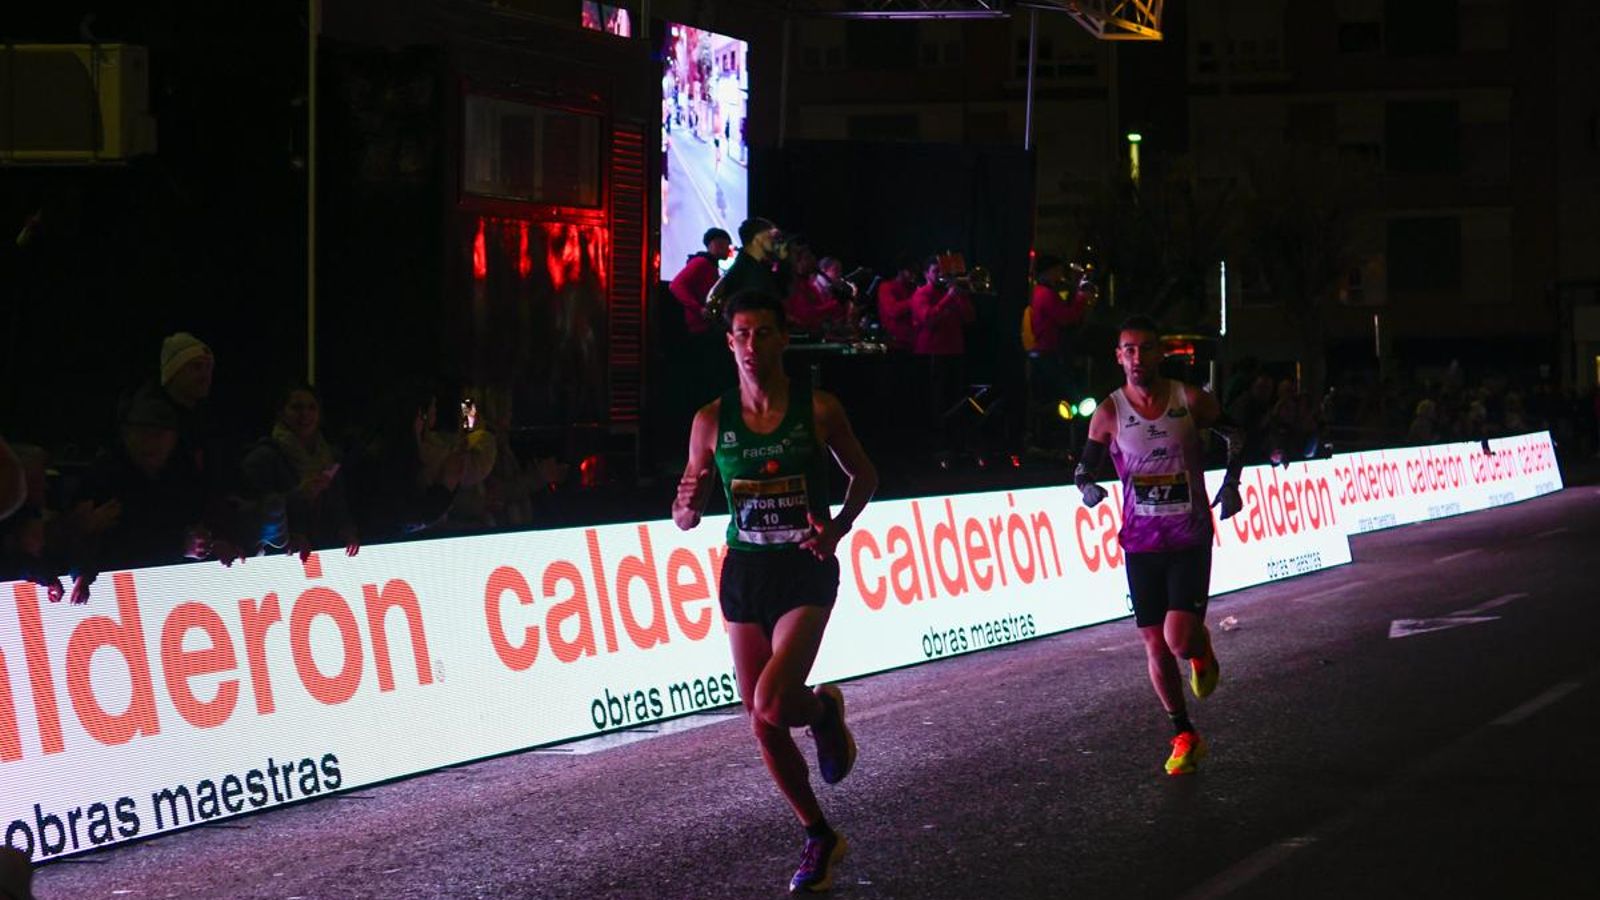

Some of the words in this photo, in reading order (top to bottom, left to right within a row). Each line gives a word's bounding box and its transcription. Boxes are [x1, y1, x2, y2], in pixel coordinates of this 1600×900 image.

[779, 494, 806, 509] RUIZ
[1148, 485, 1172, 501] 47
[1232, 463, 1336, 543] calderón
[1335, 450, 1404, 505] calderón
[763, 512, 779, 526] 10
[851, 492, 1062, 611] calderón
[484, 524, 730, 672] calder
[0, 552, 434, 763] lderón
[922, 627, 968, 657] obras
[970, 613, 1035, 645] maestras
[591, 686, 663, 730] obras
[669, 671, 737, 713] maes
[5, 796, 140, 861] obras
[153, 753, 342, 830] maestras
